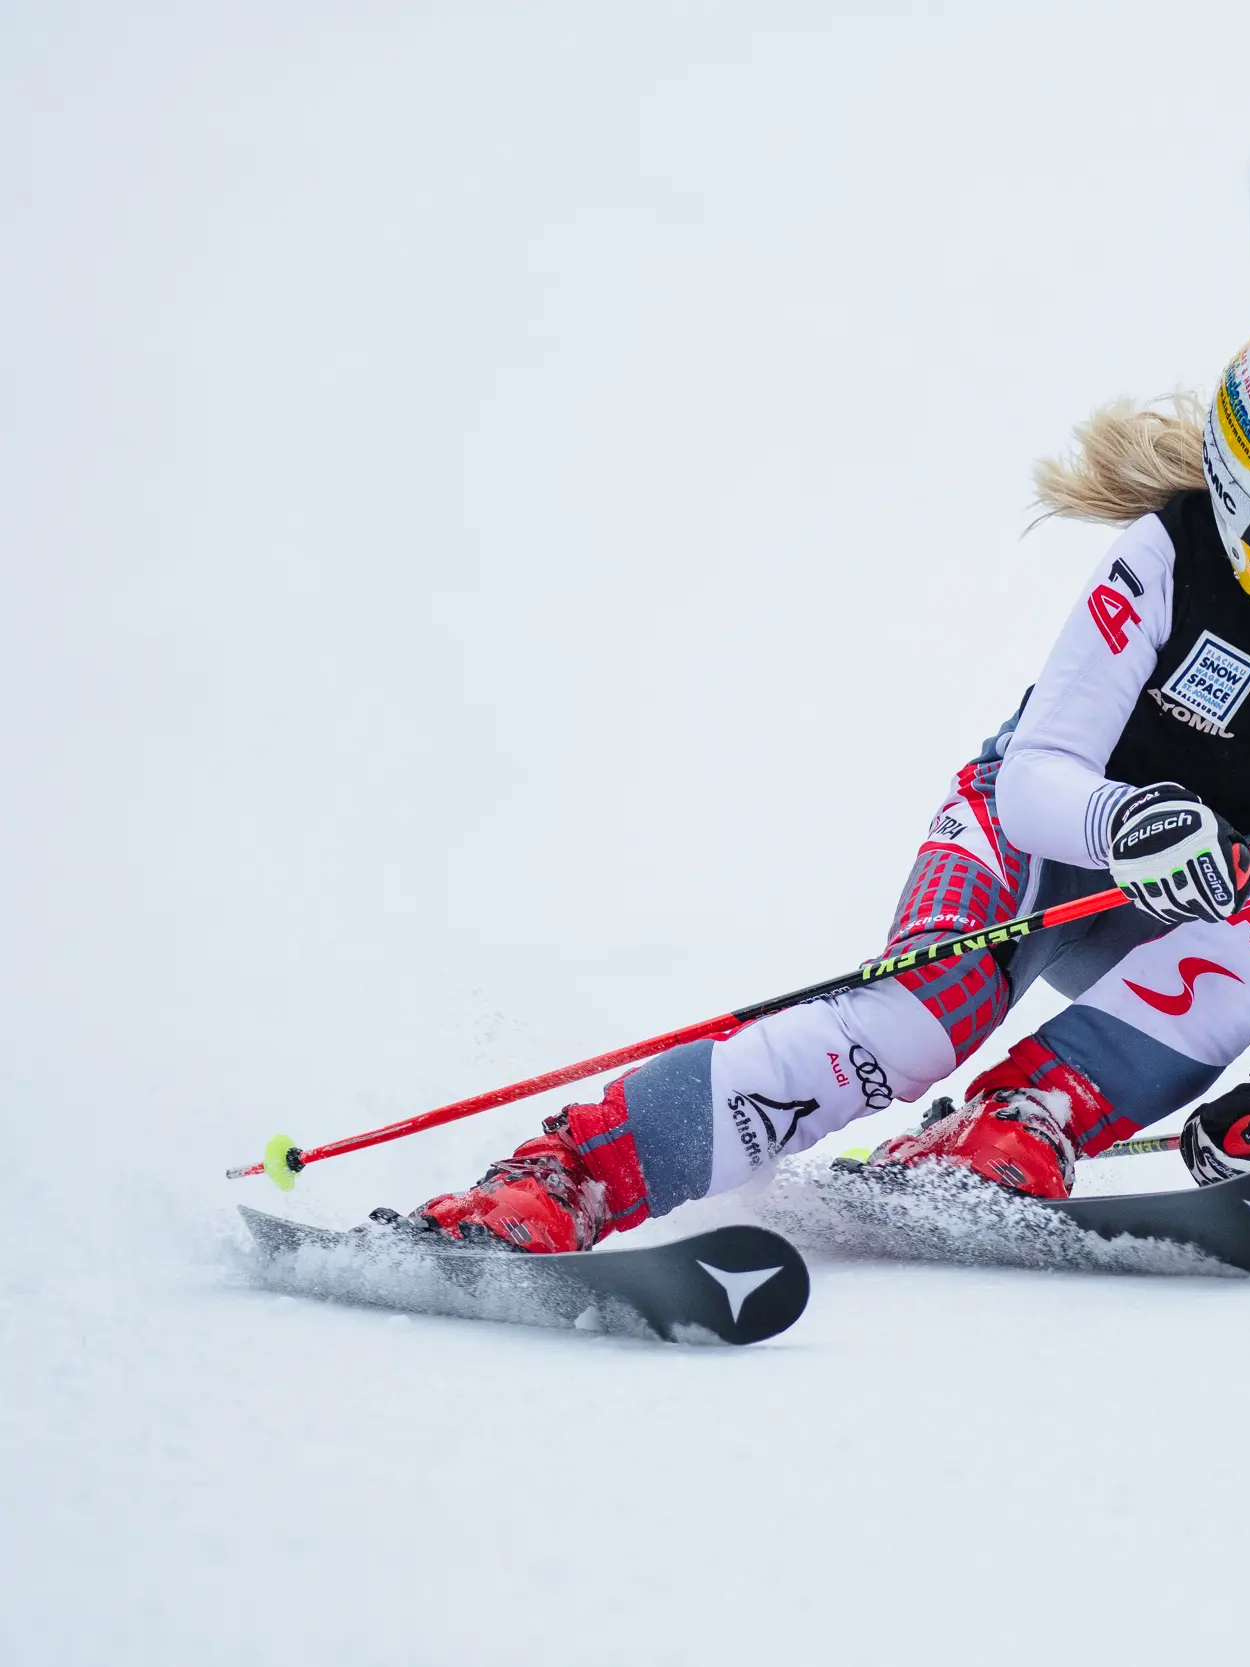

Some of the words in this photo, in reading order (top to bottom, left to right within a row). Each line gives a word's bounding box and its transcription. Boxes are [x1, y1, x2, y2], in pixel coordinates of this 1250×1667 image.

[1087, 557, 1146, 656] A1
[1199, 656, 1242, 686] SNOW
[1206, 649, 1247, 676] FLACHAU
[1187, 673, 1231, 704] SPACE
[1195, 667, 1235, 693] WAGRAIN
[1176, 690, 1218, 717] SALZBURG
[1191, 688, 1224, 710] JOHANN
[1120, 812, 1192, 853] reusch
[1199, 856, 1229, 901] racing
[953, 922, 1030, 956] LEKI
[826, 1051, 850, 1088] Audi
